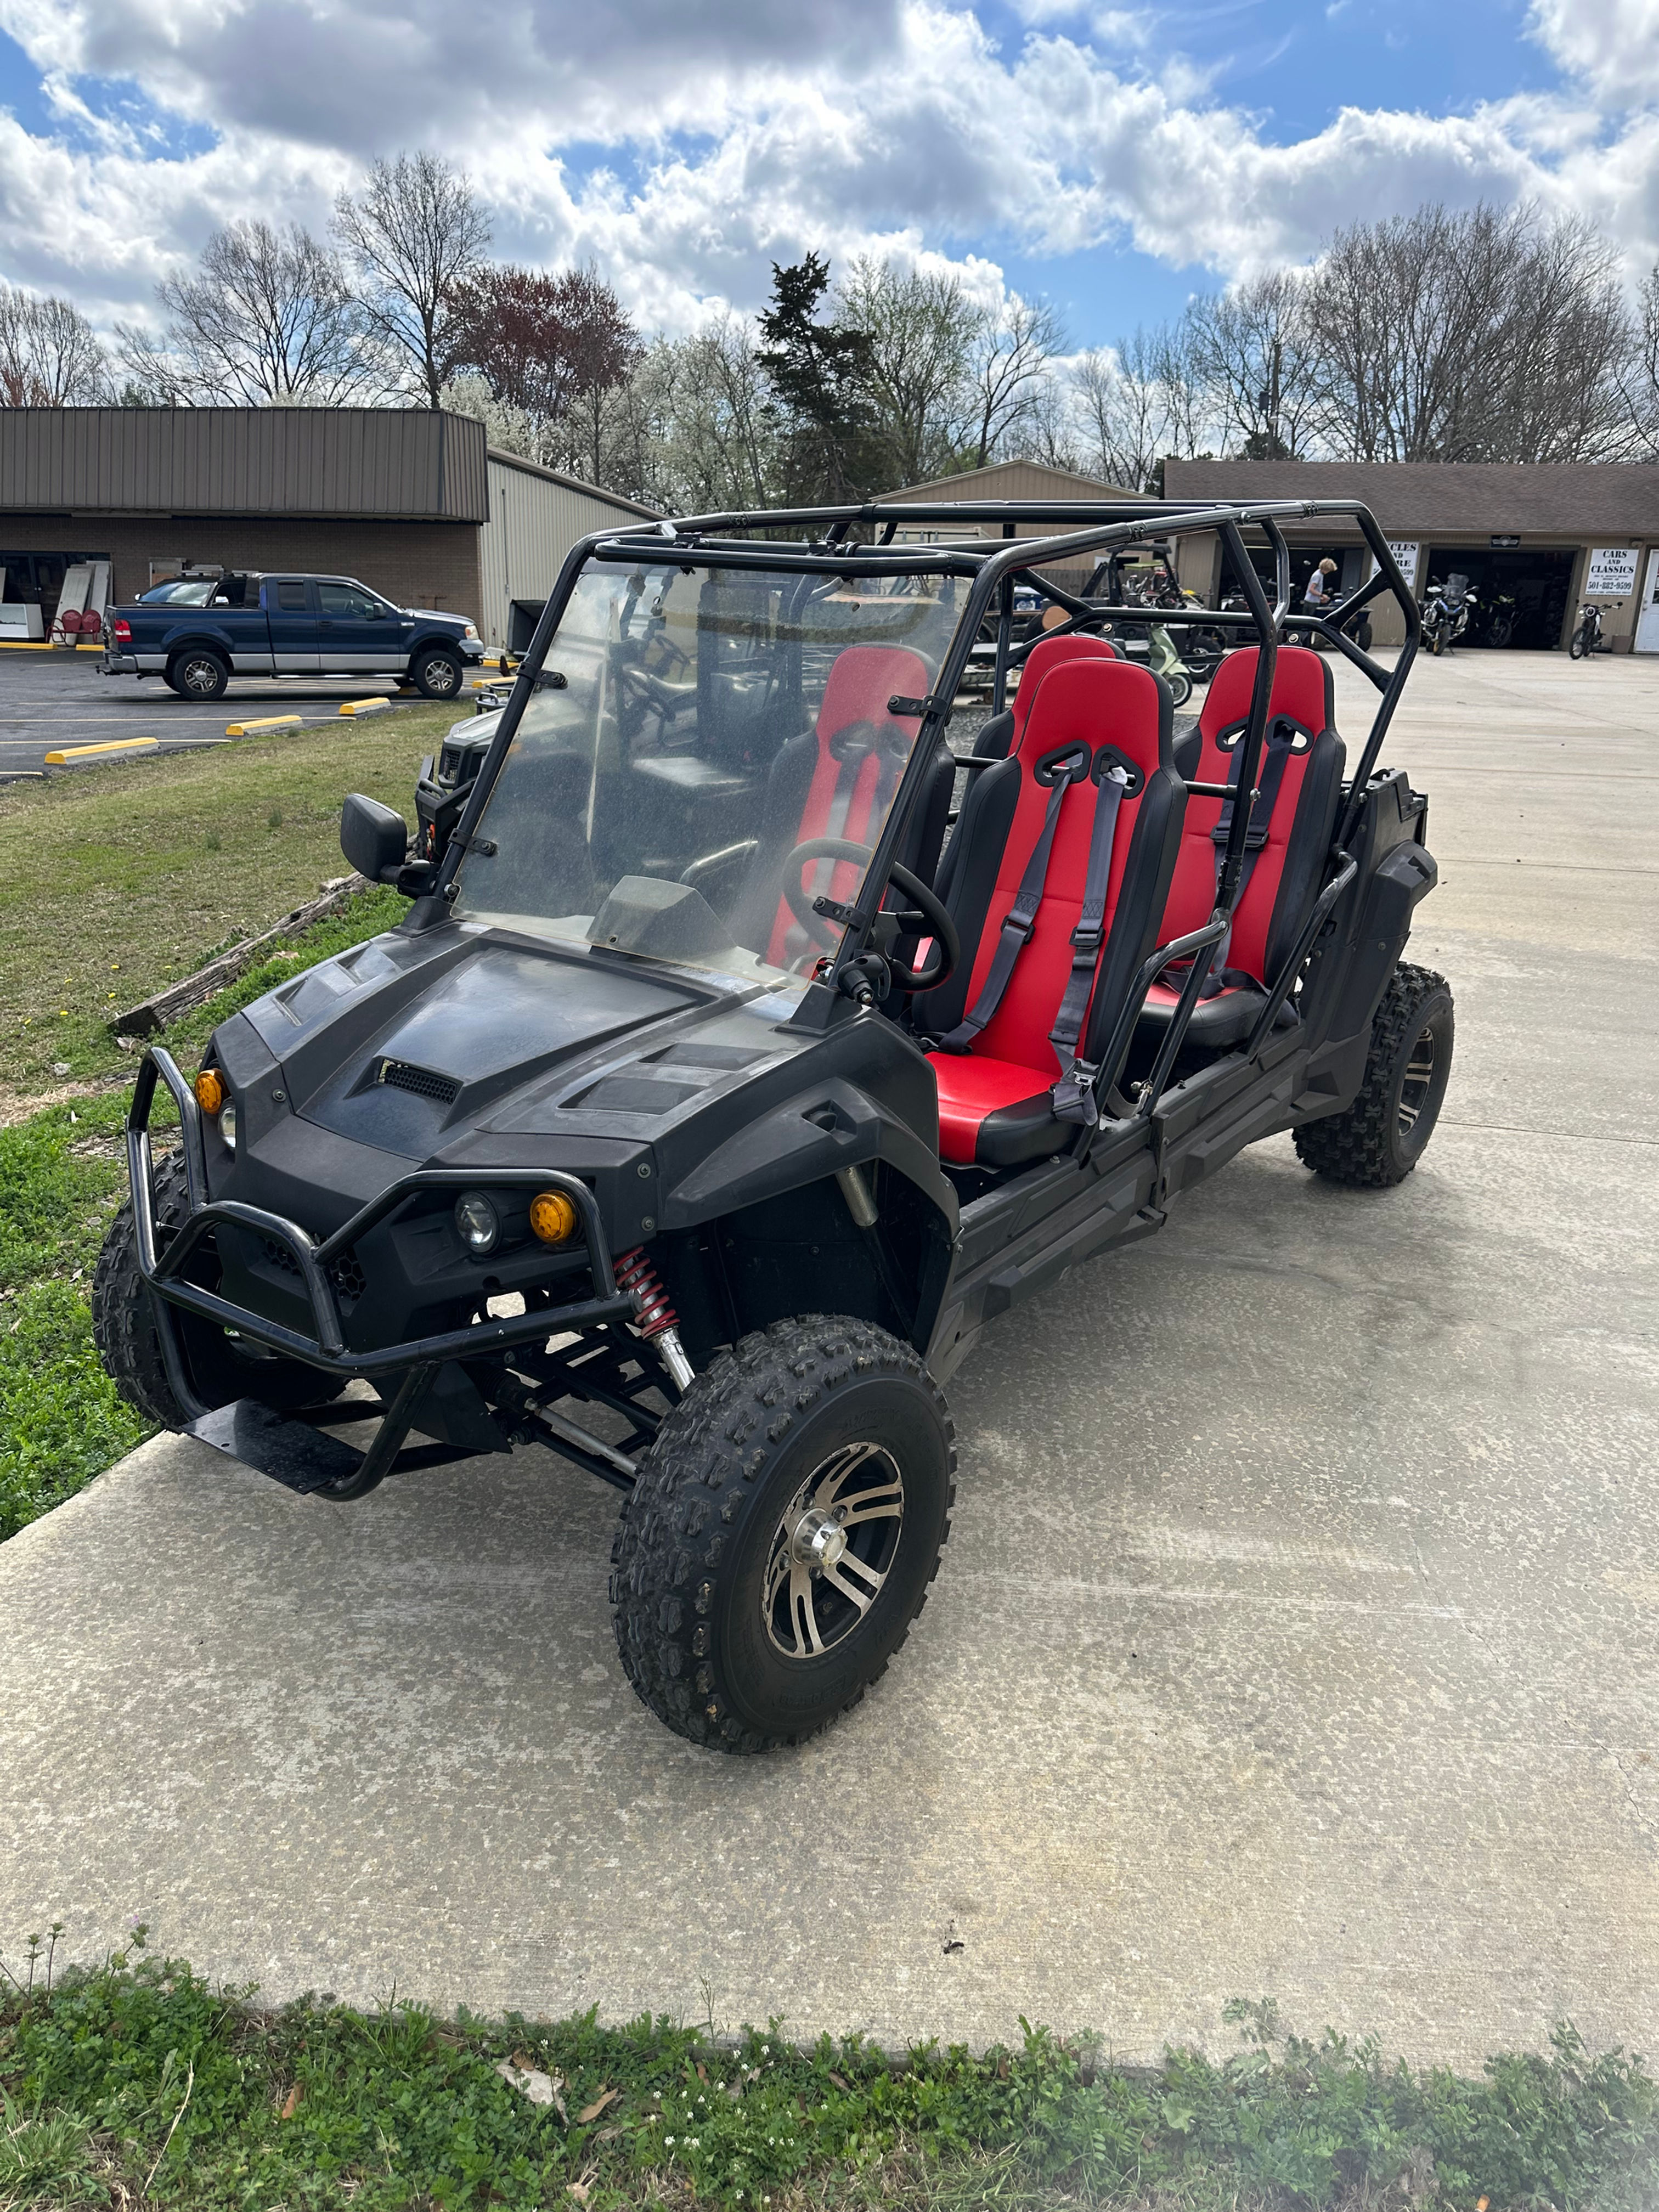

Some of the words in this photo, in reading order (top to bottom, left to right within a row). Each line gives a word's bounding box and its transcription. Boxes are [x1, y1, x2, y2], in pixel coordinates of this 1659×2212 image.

[1389, 543, 1417, 552] CLES
[1591, 566, 1634, 574] CLASSICS
[1588, 582, 1632, 590] 501-882-9599
